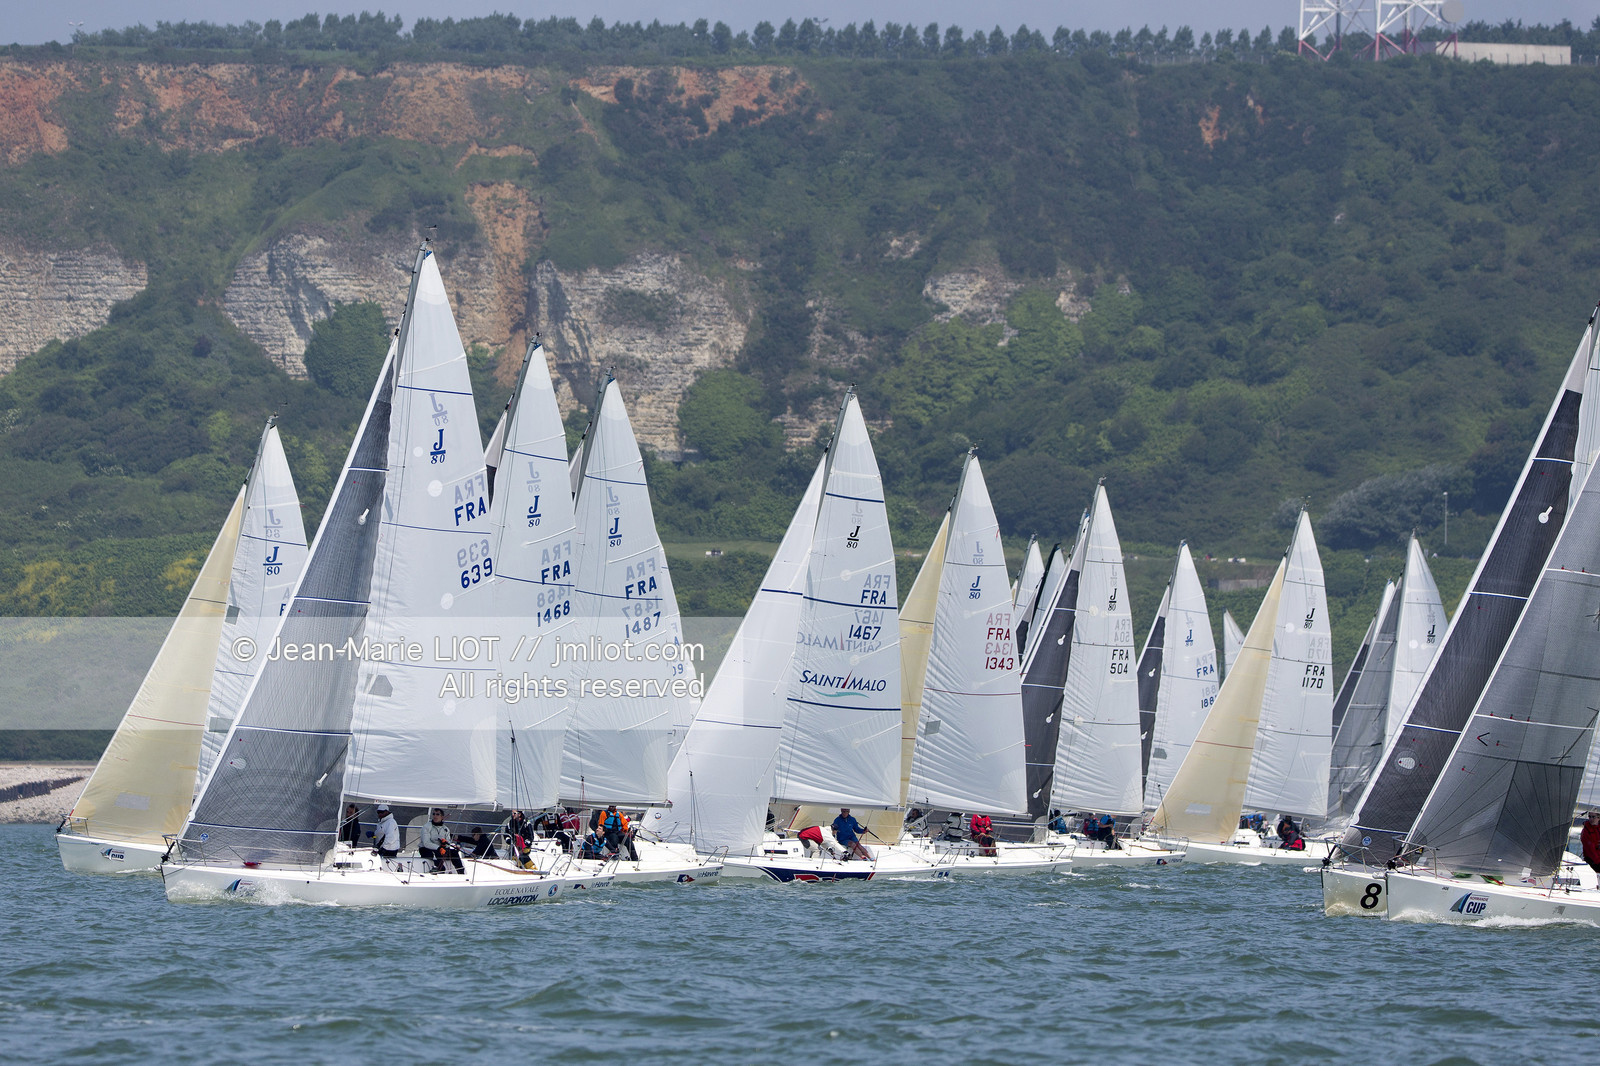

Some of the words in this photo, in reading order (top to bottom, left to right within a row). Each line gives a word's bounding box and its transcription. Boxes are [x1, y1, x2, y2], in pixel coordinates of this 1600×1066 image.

[433, 429, 444, 450] J
[431, 455, 445, 464] 80
[528, 495, 540, 513] J
[454, 497, 486, 526] FRA
[528, 518, 540, 528] 80
[609, 517, 620, 534] J
[850, 526, 860, 537] J
[609, 539, 621, 547] 80
[266, 546, 279, 562] J
[266, 566, 280, 575] 80
[461, 558, 492, 588] 639
[541, 560, 571, 585] FRA
[625, 576, 657, 600] FRA
[971, 576, 981, 588] J
[860, 590, 887, 605] FRA
[1110, 588, 1117, 600] J
[537, 600, 570, 627] 1468
[1306, 608, 1315, 619] J
[625, 611, 661, 638] 1487
[1428, 625, 1435, 634] J
[849, 625, 881, 640] 1467
[987, 628, 1010, 640] FRA
[1186, 629, 1192, 640] J
[1112, 649, 1129, 660] FRA
[985, 657, 1014, 670] 1343
[1110, 663, 1128, 674] 504
[1196, 664, 1215, 678] FRA
[1305, 664, 1325, 677] FRA
[847, 677, 886, 691] MALO
[1302, 677, 1323, 688] 1170
[1201, 696, 1217, 708] 188
[487, 894, 539, 905] LOCAPONTON
[1360, 882, 1383, 910] 8
[1466, 901, 1486, 914] CUP
